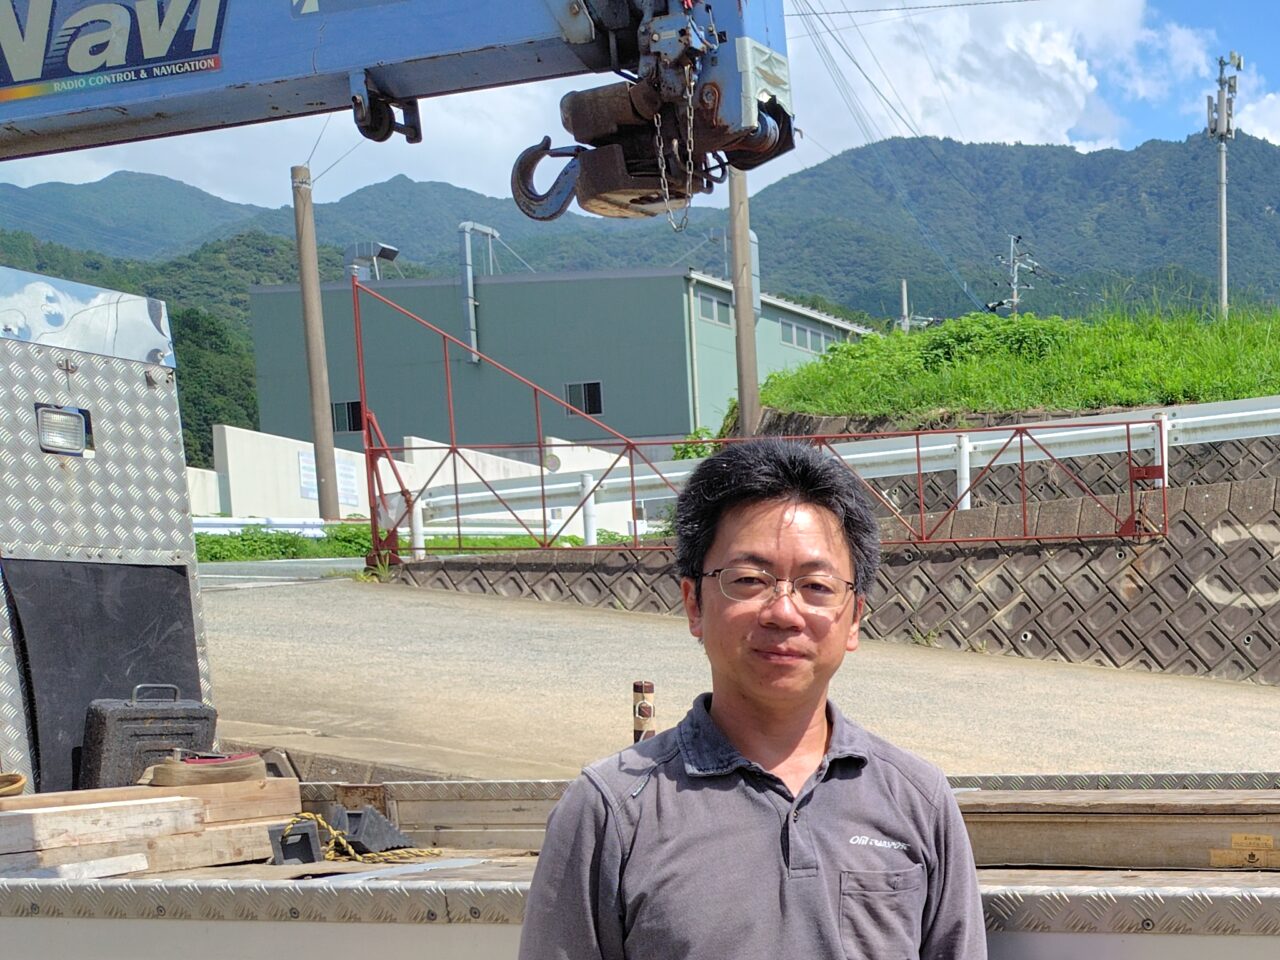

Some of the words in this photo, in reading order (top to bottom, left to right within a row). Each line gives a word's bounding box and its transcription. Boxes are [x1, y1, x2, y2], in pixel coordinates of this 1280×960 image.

[53, 78, 86, 93] RADIO
[88, 70, 137, 87] CONTROL
[139, 69, 148, 79] &
[153, 58, 215, 78] NAVIGATION
